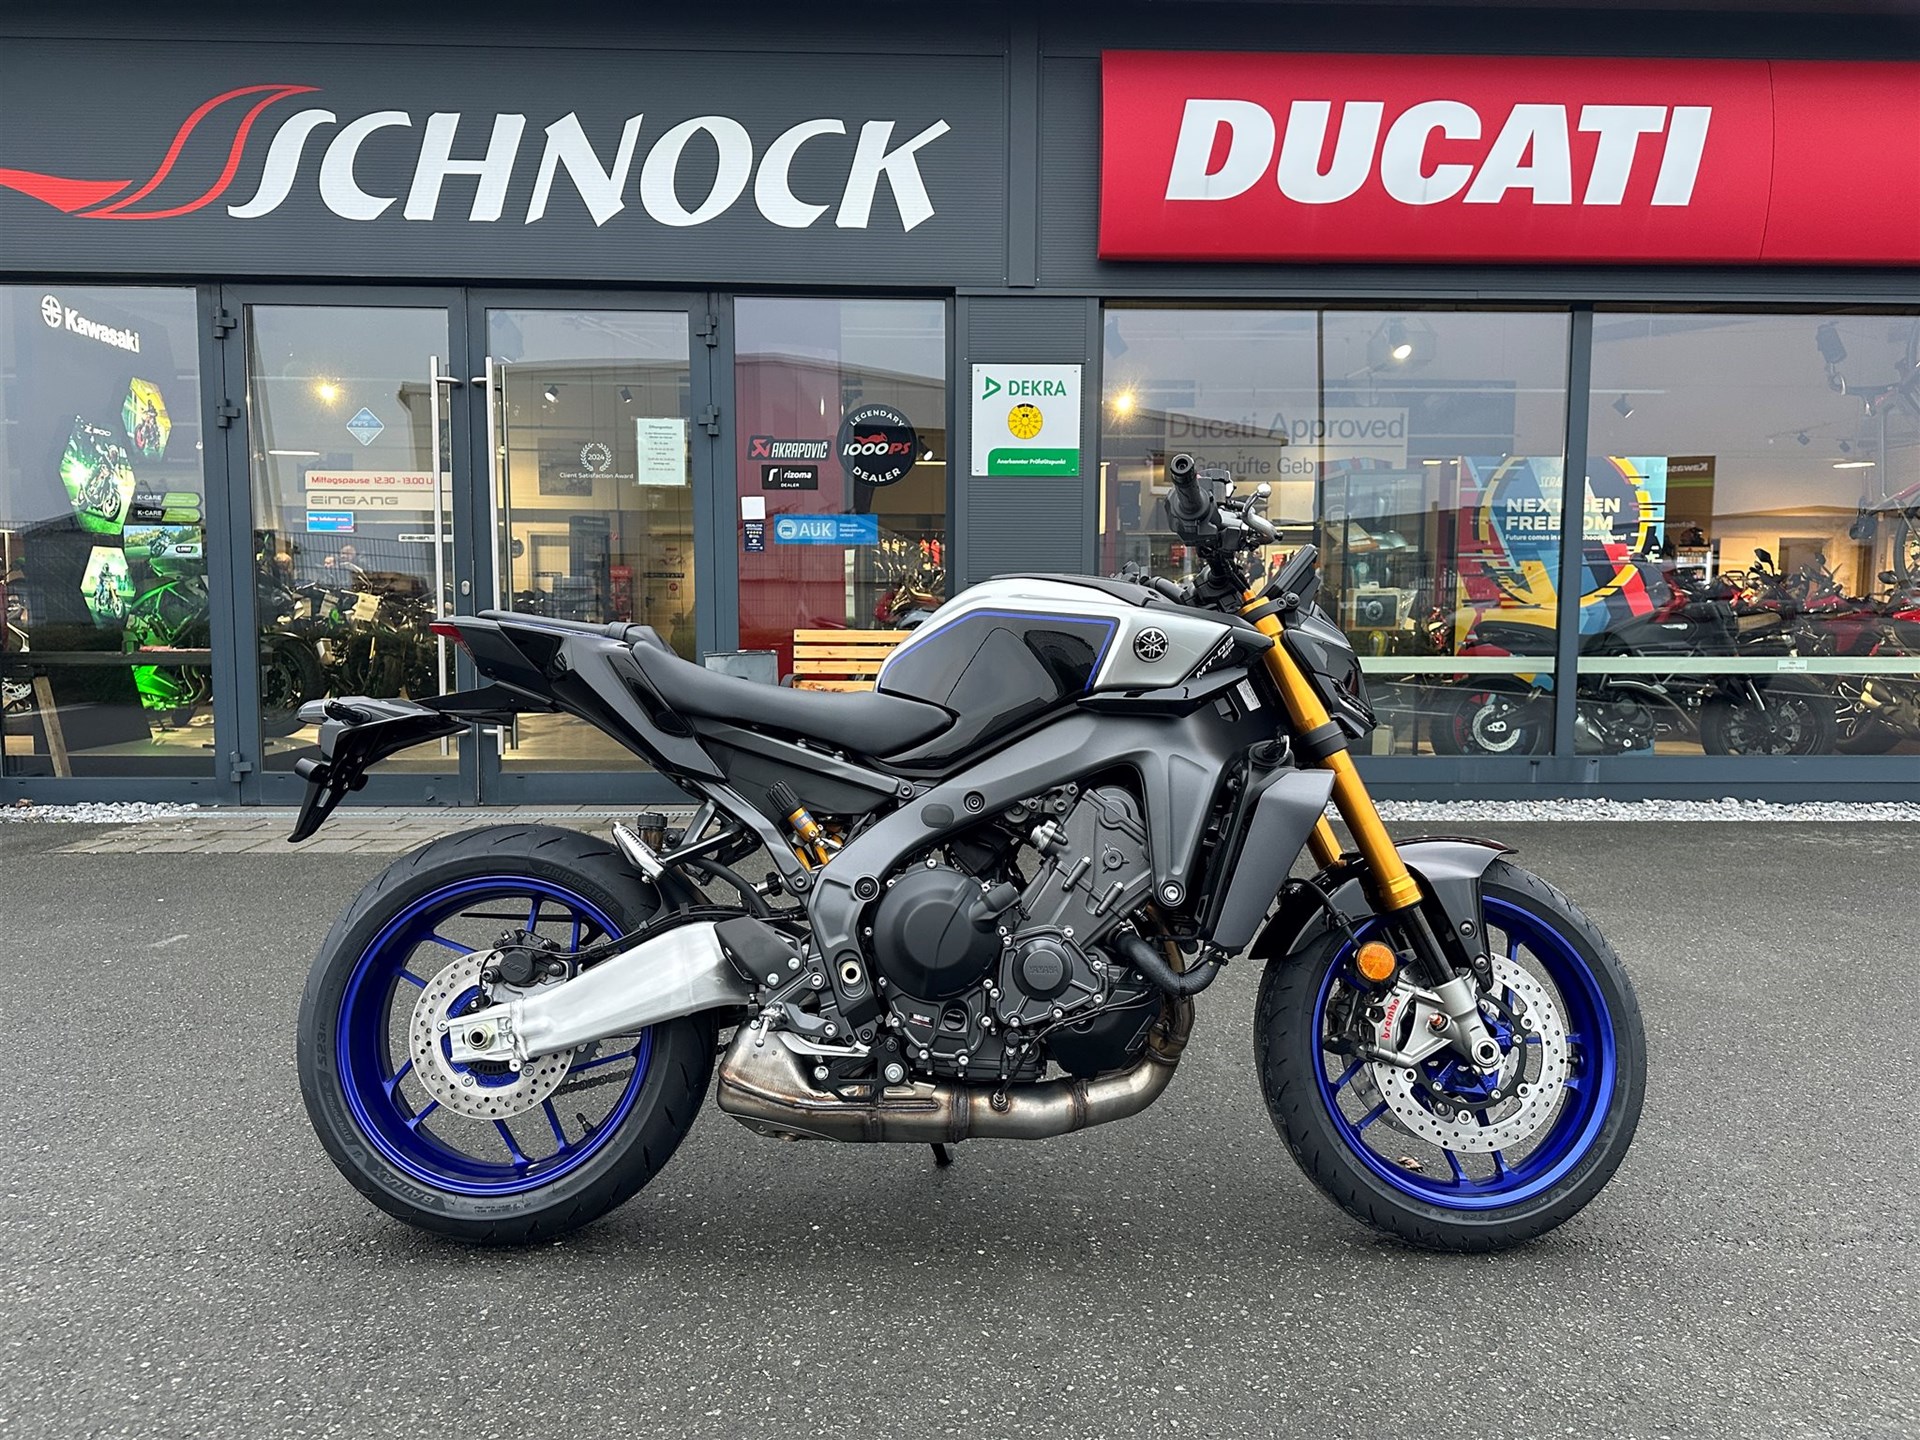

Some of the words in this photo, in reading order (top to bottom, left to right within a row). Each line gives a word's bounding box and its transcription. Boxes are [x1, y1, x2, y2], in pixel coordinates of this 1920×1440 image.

[1164, 98, 1713, 207] DUCATI
[227, 108, 952, 233] SCHNOCK
[64, 307, 140, 353] Kawasaki
[1008, 380, 1067, 396] DEKRA
[851, 409, 905, 427] LEGENDARY
[1170, 412, 1257, 439] Ducati
[1269, 412, 1406, 445] Approved
[771, 441, 828, 458] AKRAPOVIČ
[843, 440, 911, 456] 1000PS
[587, 453, 606, 461] 2024
[311, 476, 370, 485] Mittagspause
[374, 477, 396, 485] 12.30
[403, 477, 424, 485] 13.00
[783, 470, 812, 480] rizoma
[853, 466, 901, 482] DEALER
[1506, 498, 1562, 513] NEXT
[799, 522, 832, 537] AÜK
[1505, 516, 1614, 531] FREEOM
[1196, 635, 1235, 679] MT-09
[1381, 998, 1400, 1040] brembo
